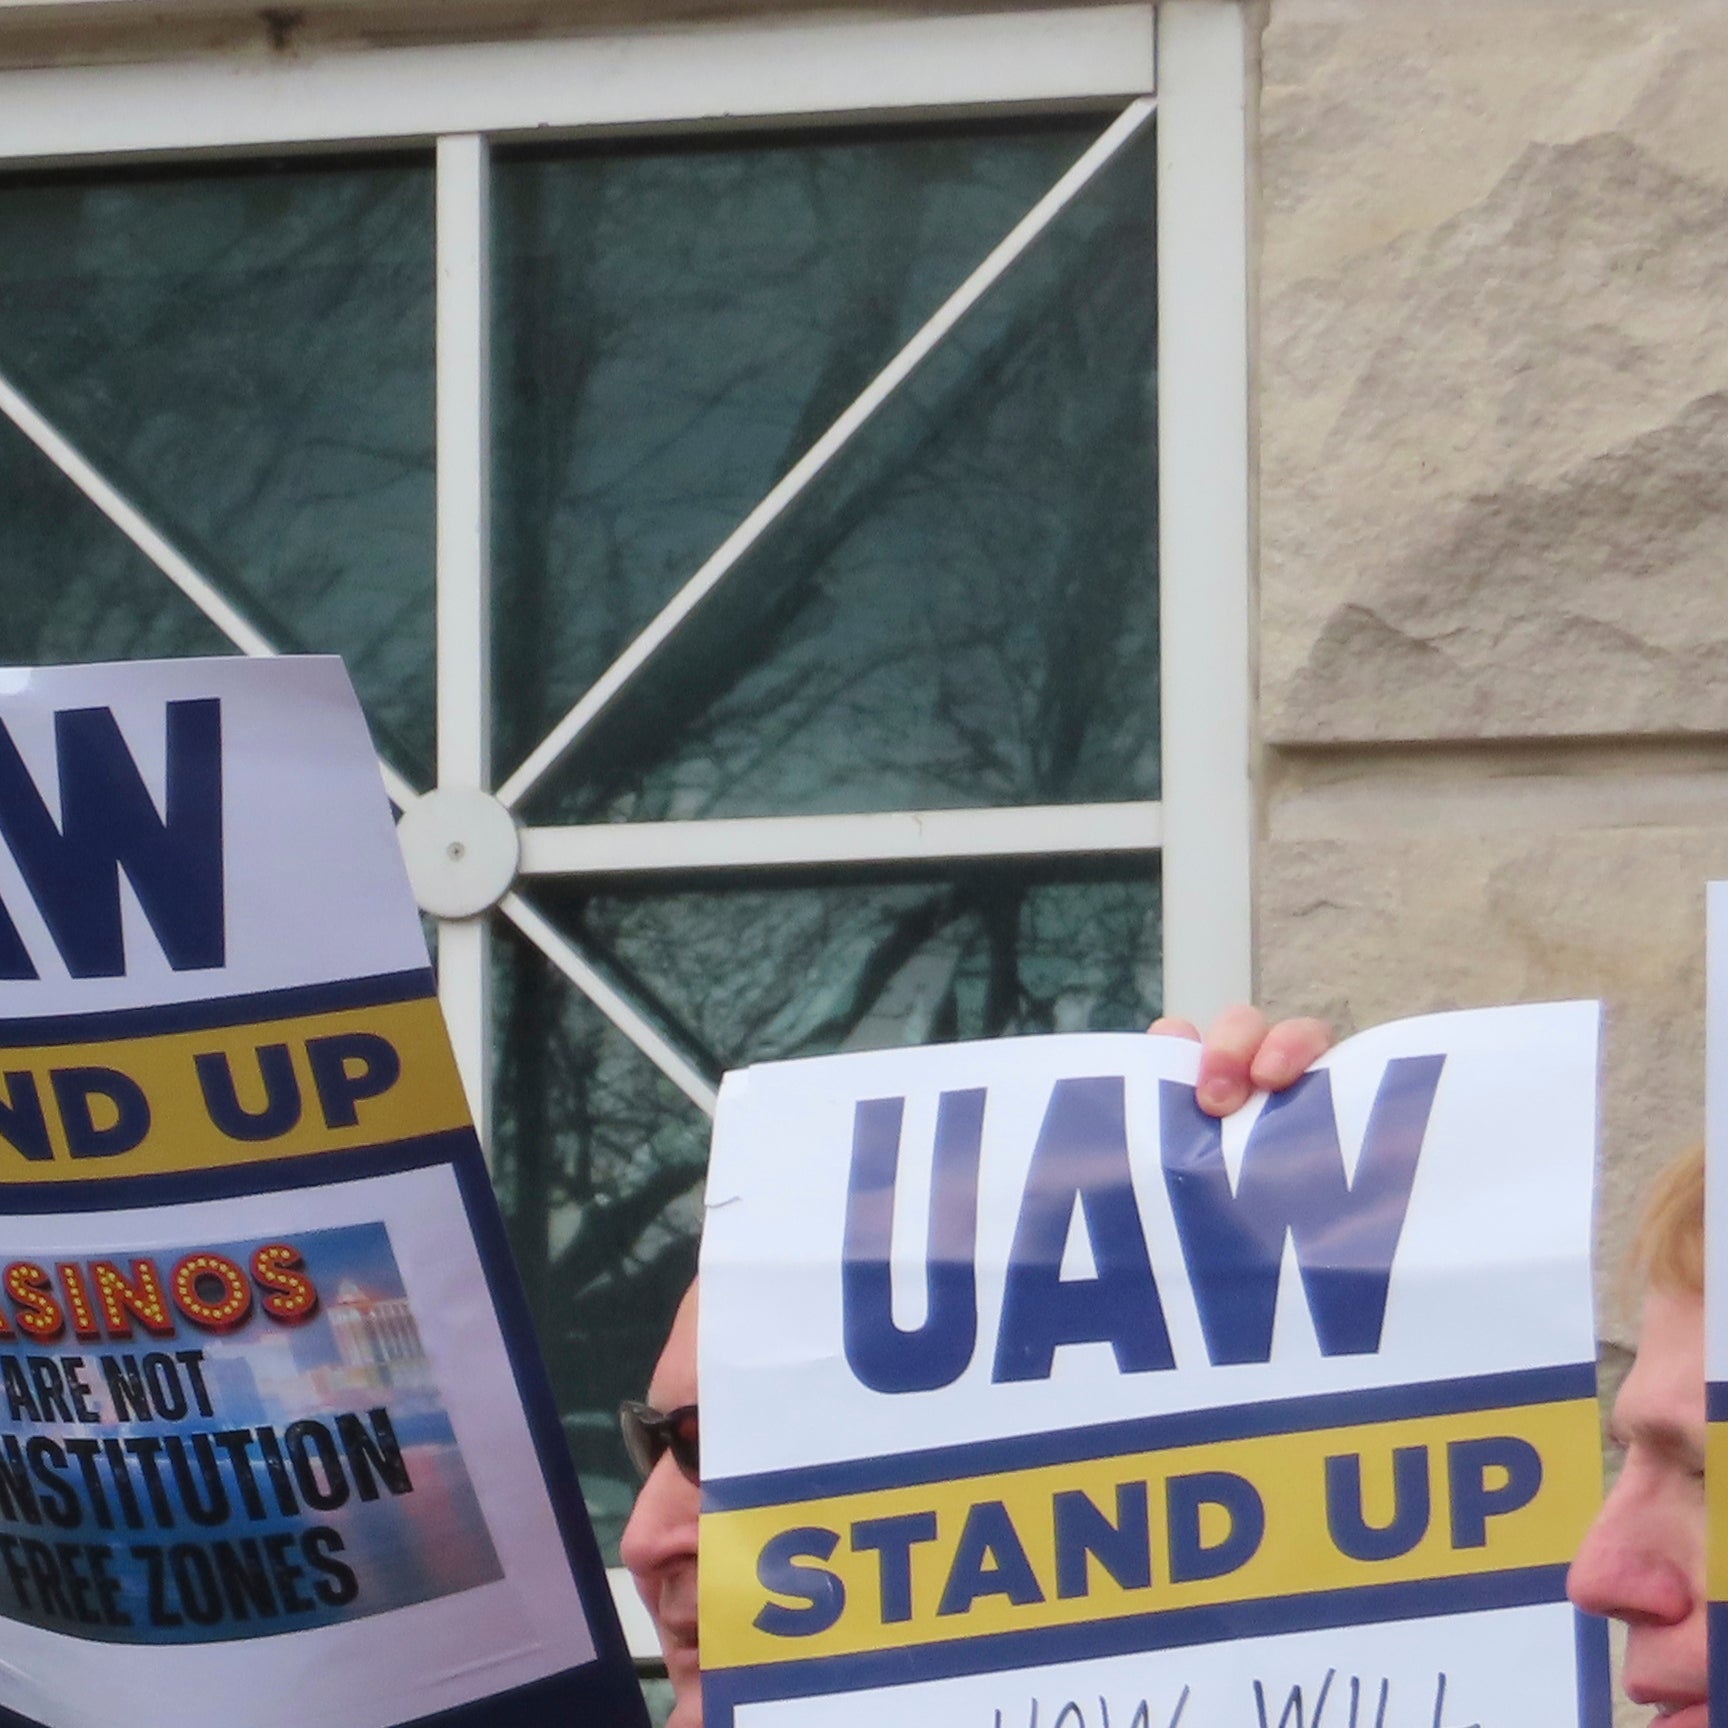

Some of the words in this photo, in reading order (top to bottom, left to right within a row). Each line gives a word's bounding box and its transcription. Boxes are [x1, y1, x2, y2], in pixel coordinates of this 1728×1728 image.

[193, 1031, 401, 1143] UP
[840, 1053, 1446, 1395] UAW
[0, 1354, 101, 1425] ARE
[107, 1348, 214, 1423] NOT
[146, 1523, 361, 1629] ZONES
[751, 1468, 1266, 1639] STAND
[1324, 1434, 1544, 1563] UP
